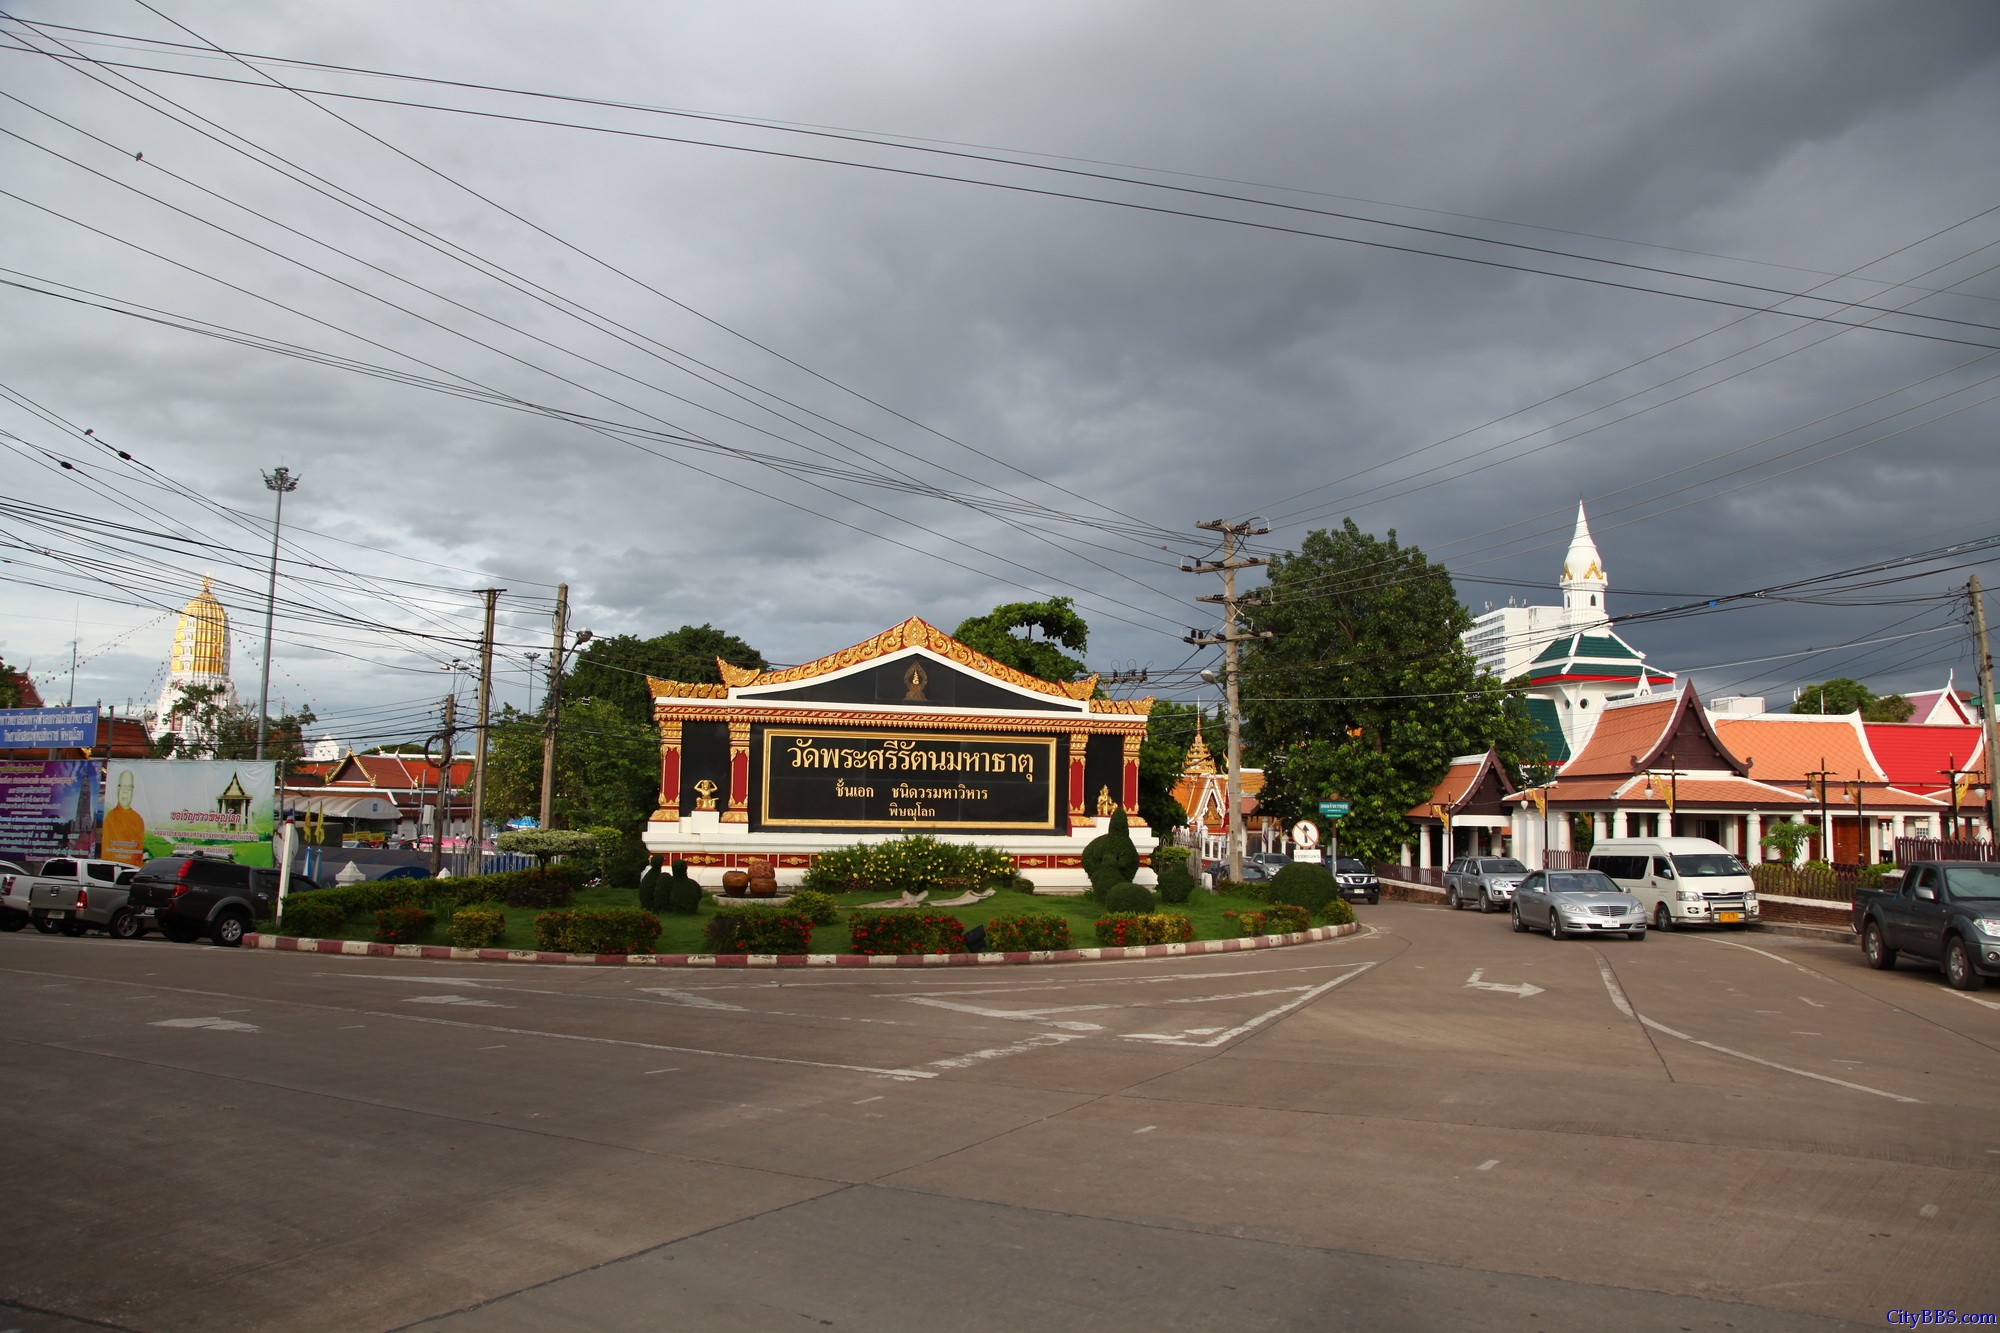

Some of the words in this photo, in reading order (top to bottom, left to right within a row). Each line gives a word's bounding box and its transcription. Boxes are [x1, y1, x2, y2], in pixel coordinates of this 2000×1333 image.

[787, 738, 1034, 782] วัดพระศรีรัตนมหาธาตุ
[836, 778, 874, 798] ชั้นเอก
[891, 783, 989, 800] ชนิดวรมหาวิหาร
[888, 801, 936, 820] พิษณุโลก
